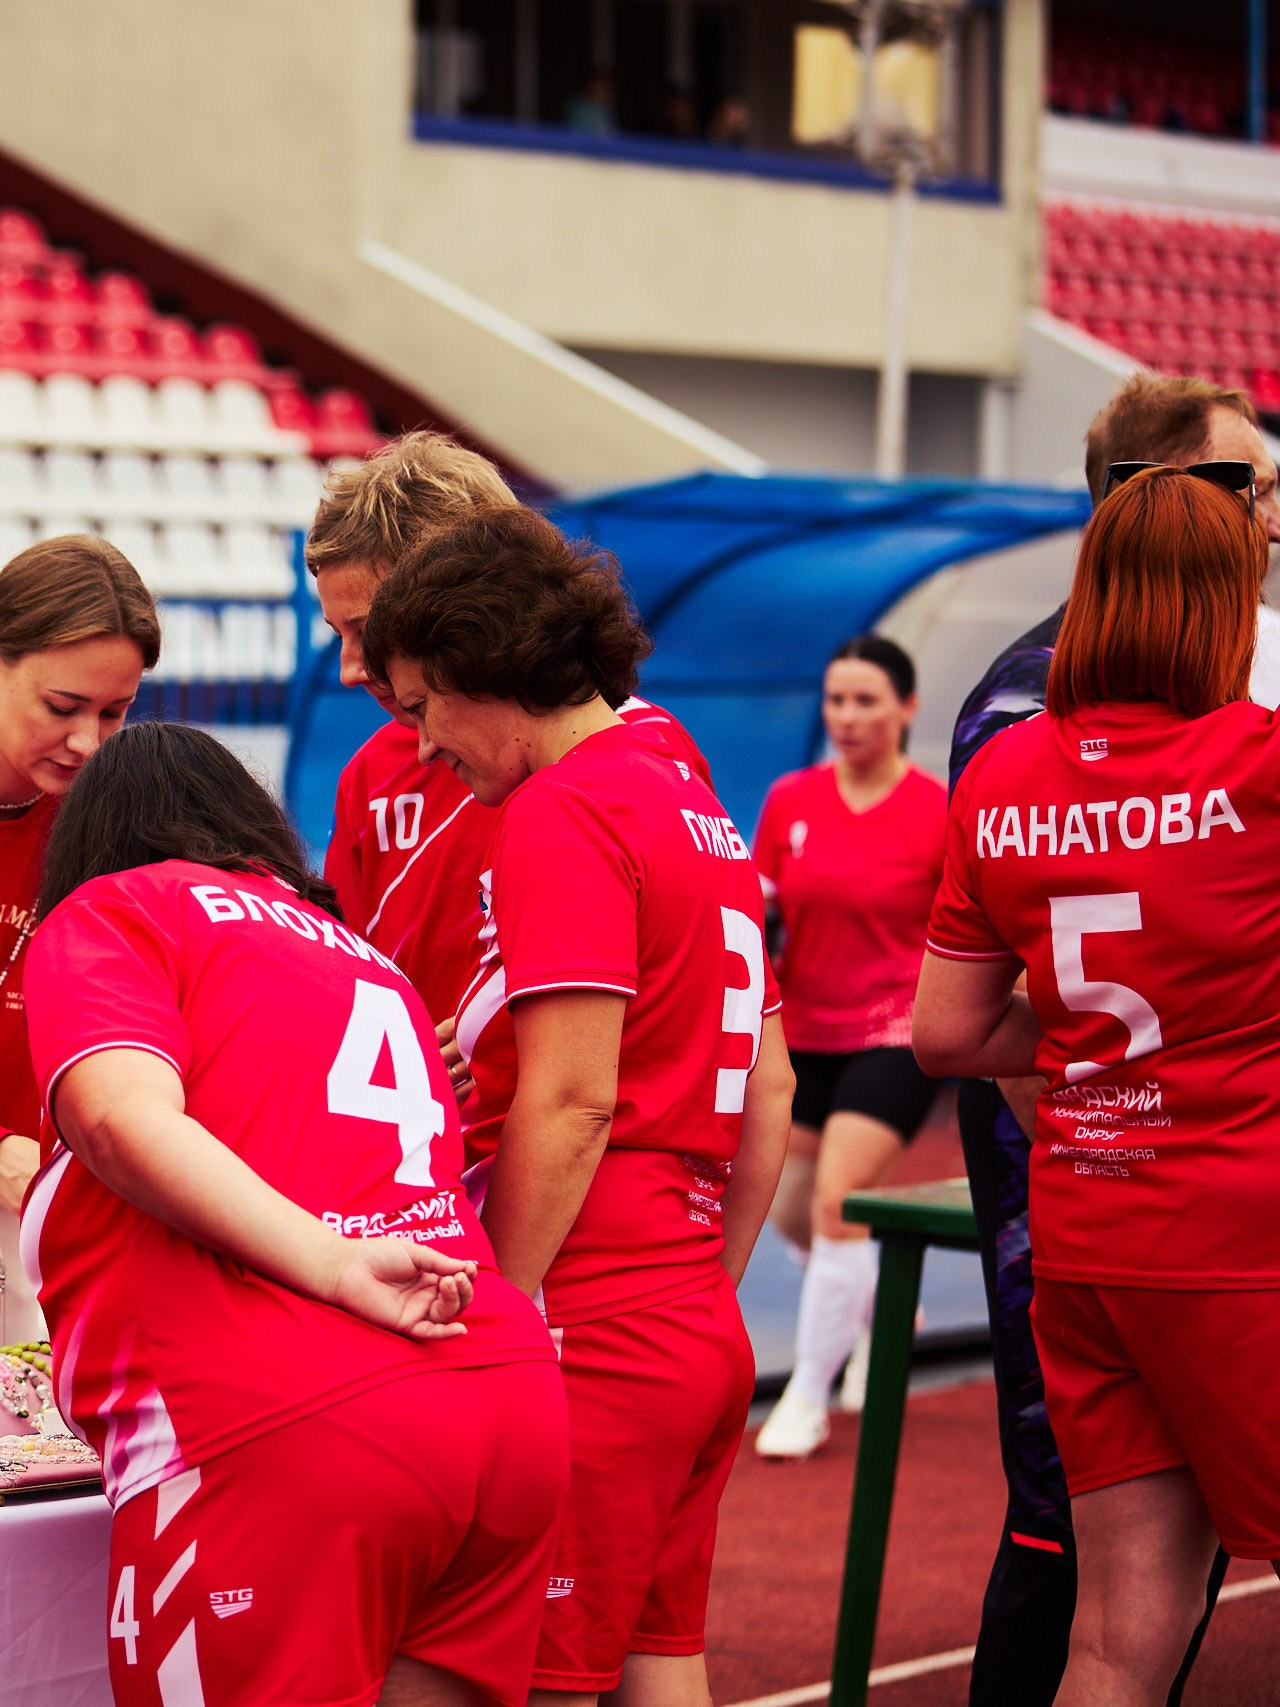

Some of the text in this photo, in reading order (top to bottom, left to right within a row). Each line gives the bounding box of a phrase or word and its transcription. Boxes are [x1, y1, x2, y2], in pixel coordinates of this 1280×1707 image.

[1080, 738, 1108, 752] STG
[368, 793, 425, 852] 10
[976, 788, 1246, 859] КАНАТОВА
[714, 905, 766, 1114] 3
[1049, 892, 1164, 1085] 5
[326, 977, 446, 1188] 4
[1050, 1143, 1156, 1162] НИЖЕГОРОДСКАЯ
[1074, 1126, 1124, 1141] ОКРУГ
[1074, 1161, 1130, 1177] ОБЛАСТЬ
[110, 1565, 140, 1665] 4
[209, 1587, 254, 1604] STG
